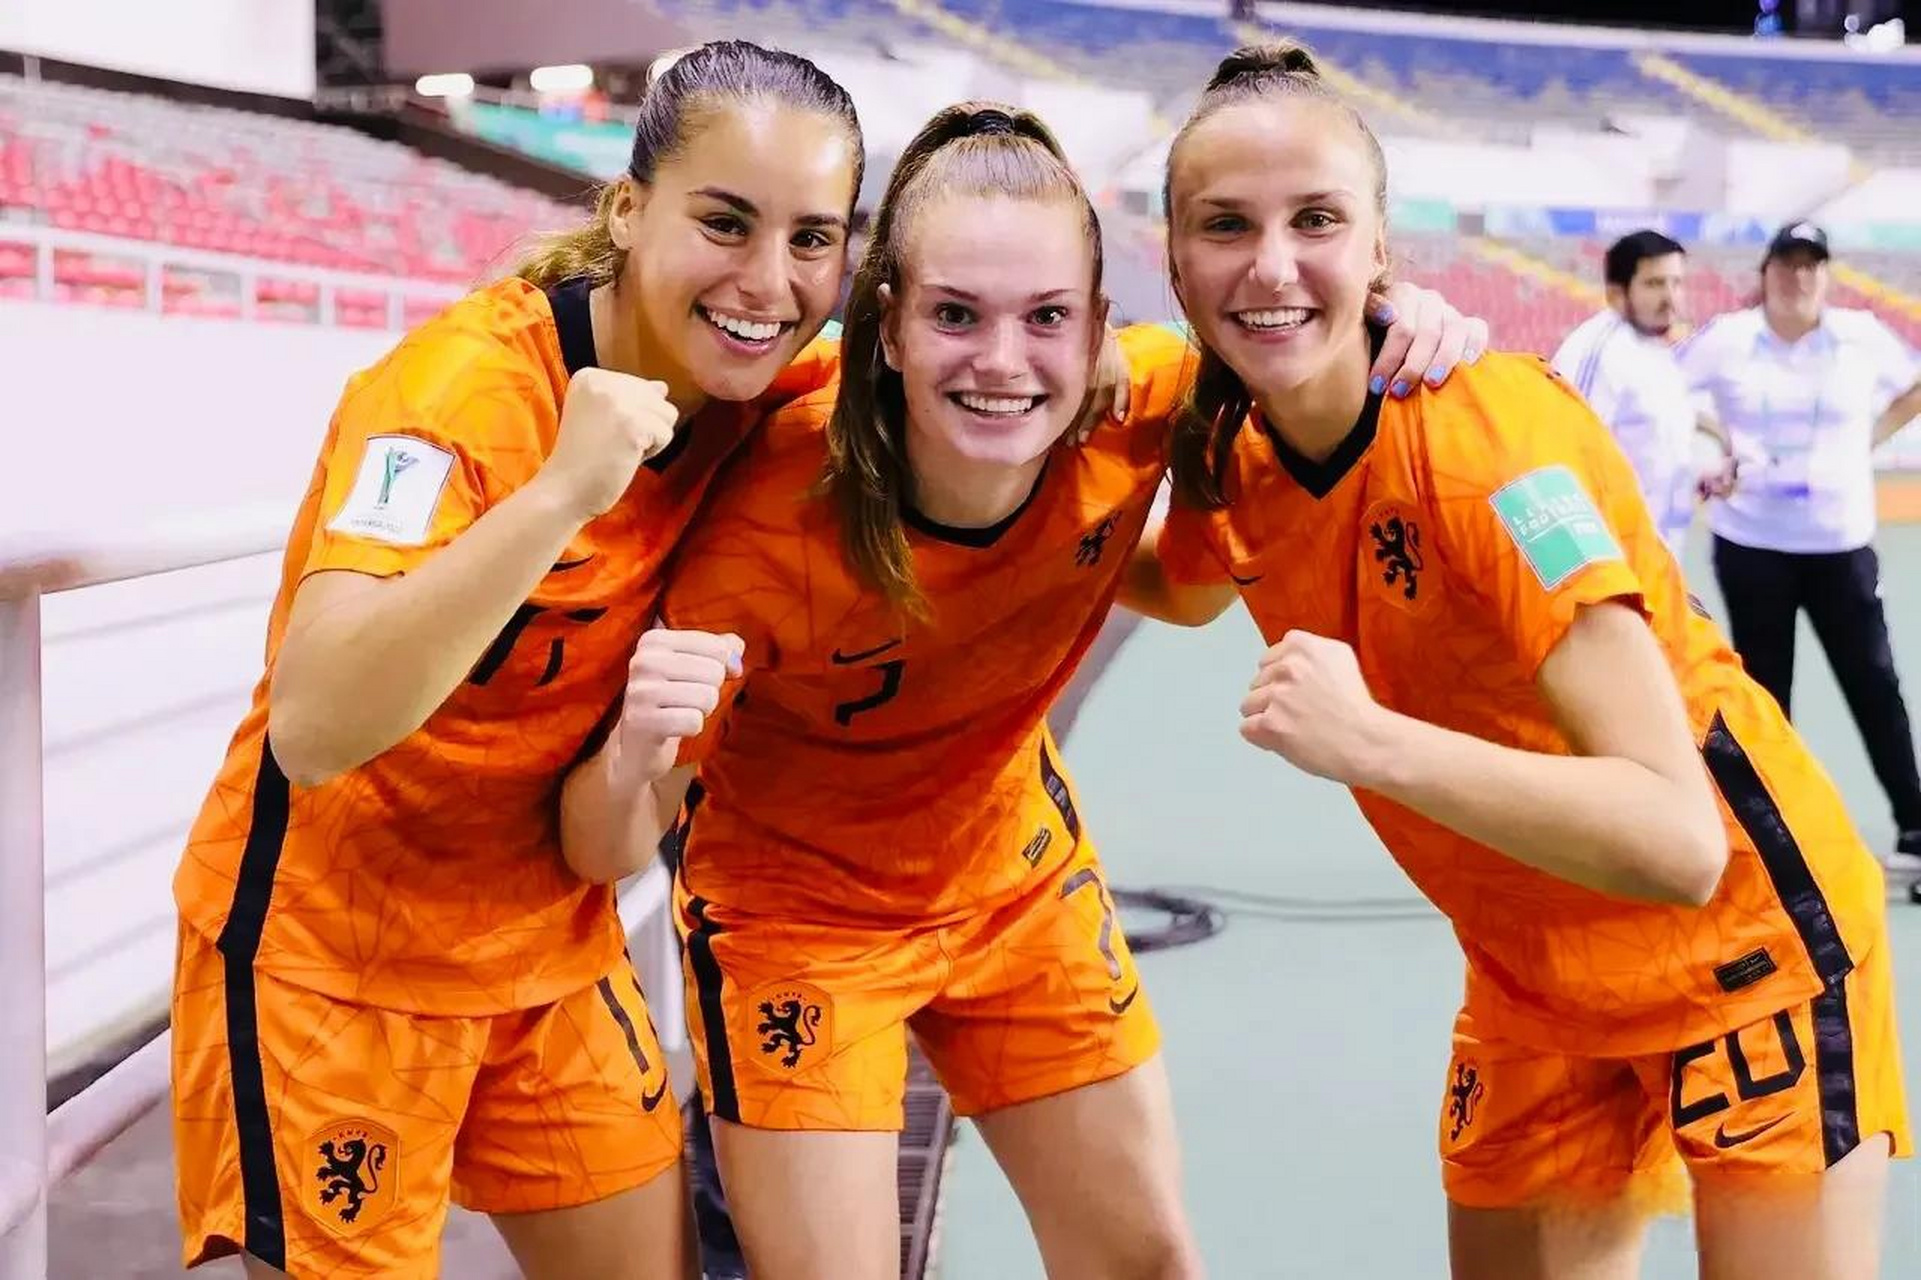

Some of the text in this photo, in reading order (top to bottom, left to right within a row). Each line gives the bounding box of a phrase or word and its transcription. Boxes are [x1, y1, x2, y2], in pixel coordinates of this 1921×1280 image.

[834, 660, 906, 727] 7
[1059, 867, 1122, 980] 7
[1671, 1009, 1806, 1128] 20
